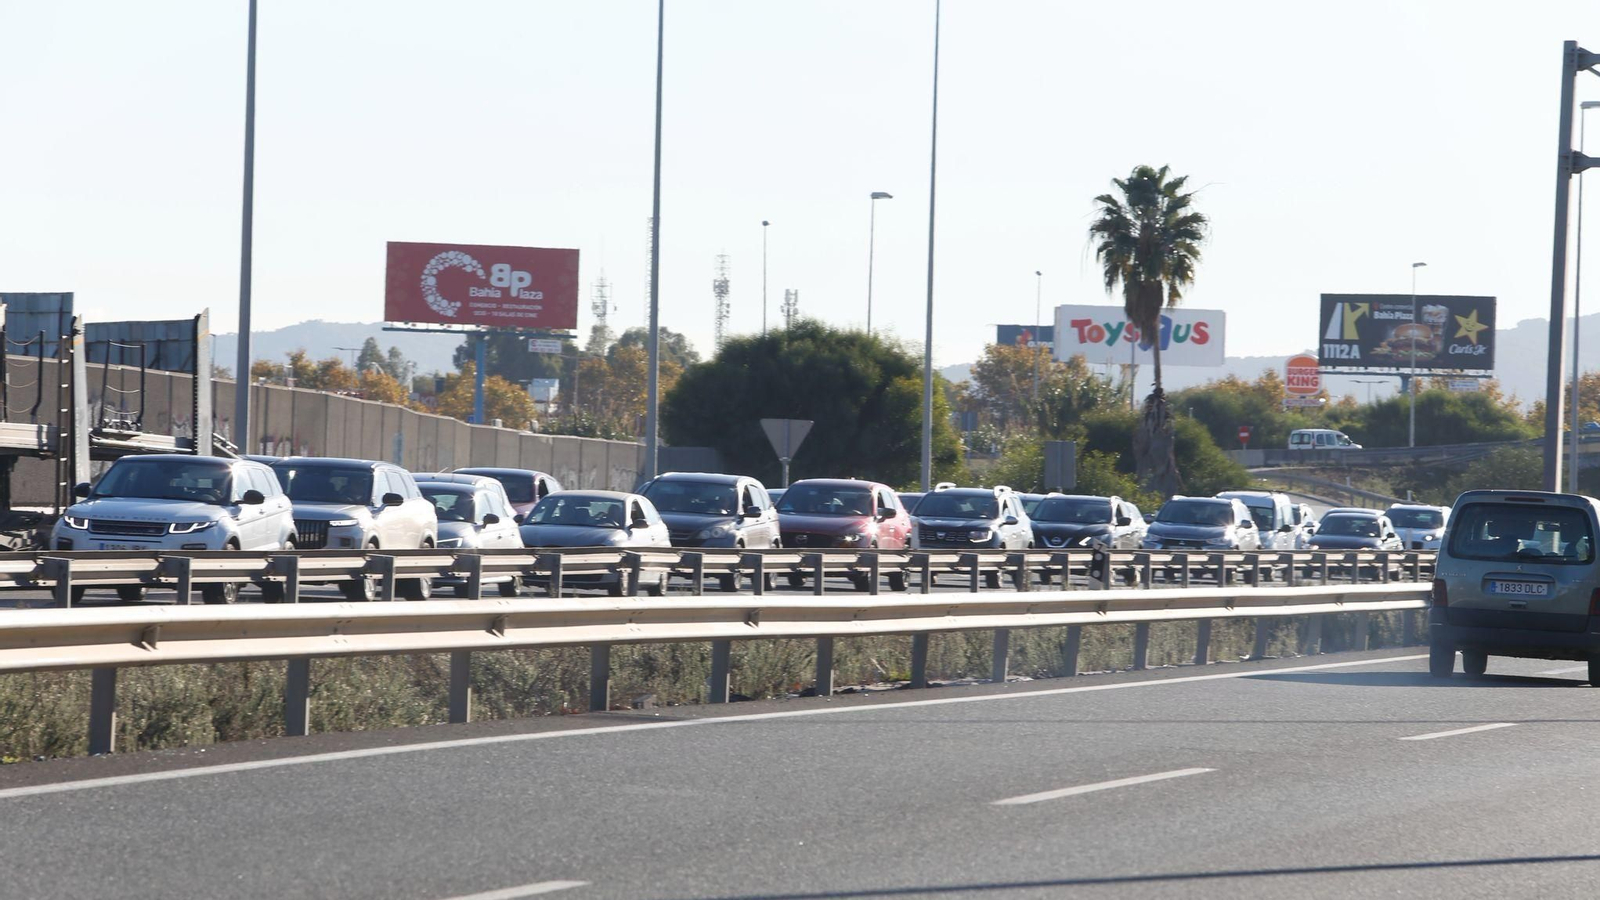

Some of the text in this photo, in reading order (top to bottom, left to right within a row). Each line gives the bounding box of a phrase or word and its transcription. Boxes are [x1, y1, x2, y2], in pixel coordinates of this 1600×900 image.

[1323, 343, 1361, 359] 1112A
[1287, 376, 1319, 387] KING
[1499, 583, 1543, 594] 1833 DLC
